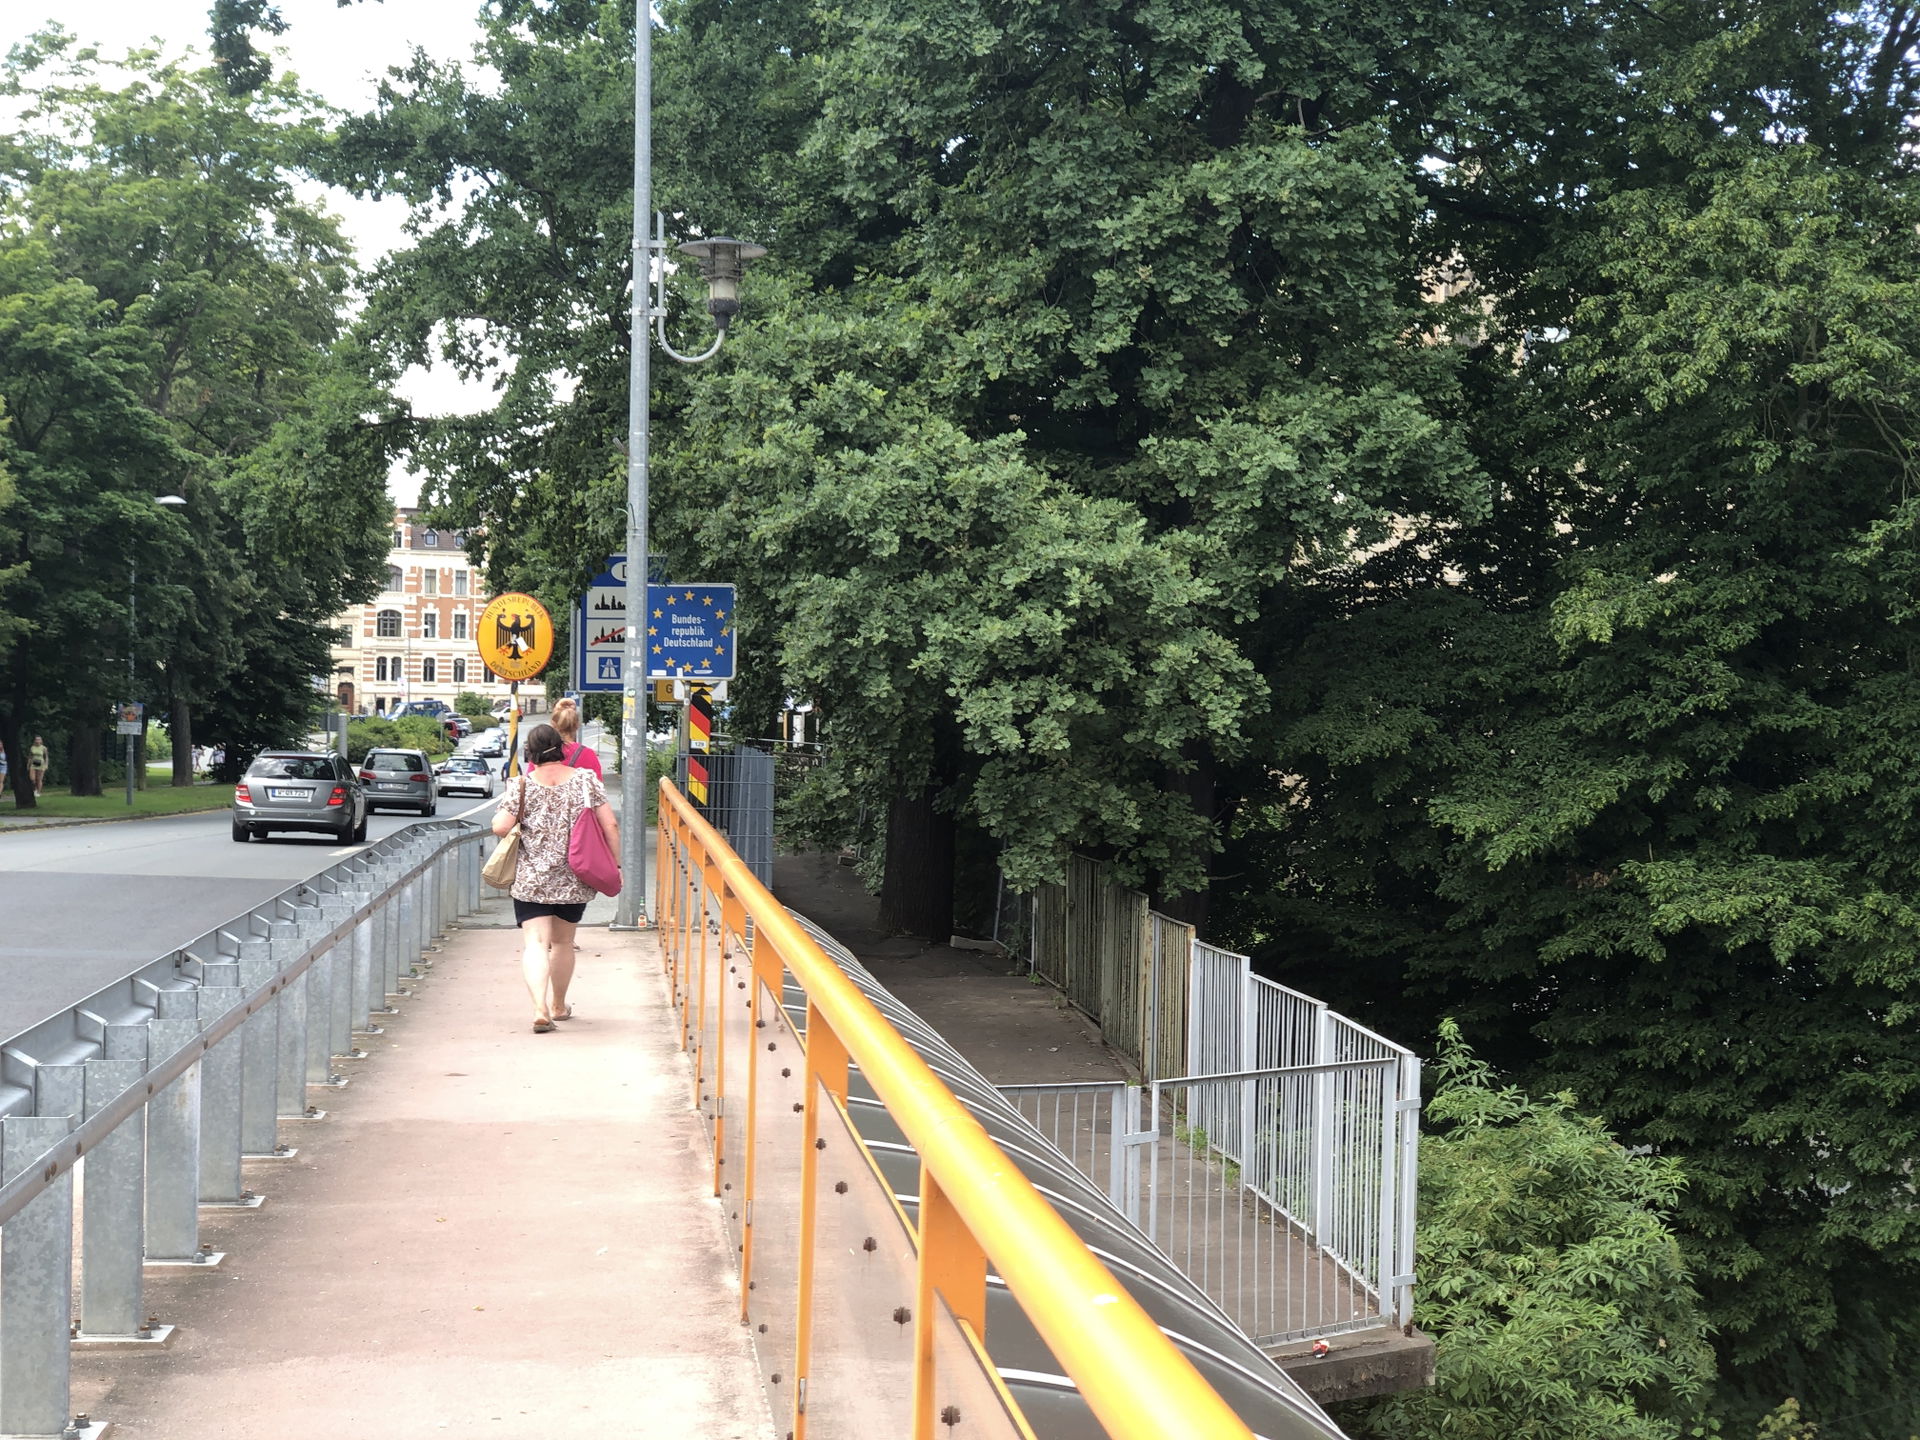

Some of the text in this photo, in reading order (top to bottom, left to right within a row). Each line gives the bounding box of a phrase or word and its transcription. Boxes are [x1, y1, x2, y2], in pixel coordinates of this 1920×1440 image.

[486, 596, 544, 620] BUNDESREPUBLIK
[671, 613, 706, 624] Bundes-
[671, 626, 705, 638] republik
[663, 636, 713, 648] Deutschland
[490, 660, 542, 678] DEUTSCHLAND
